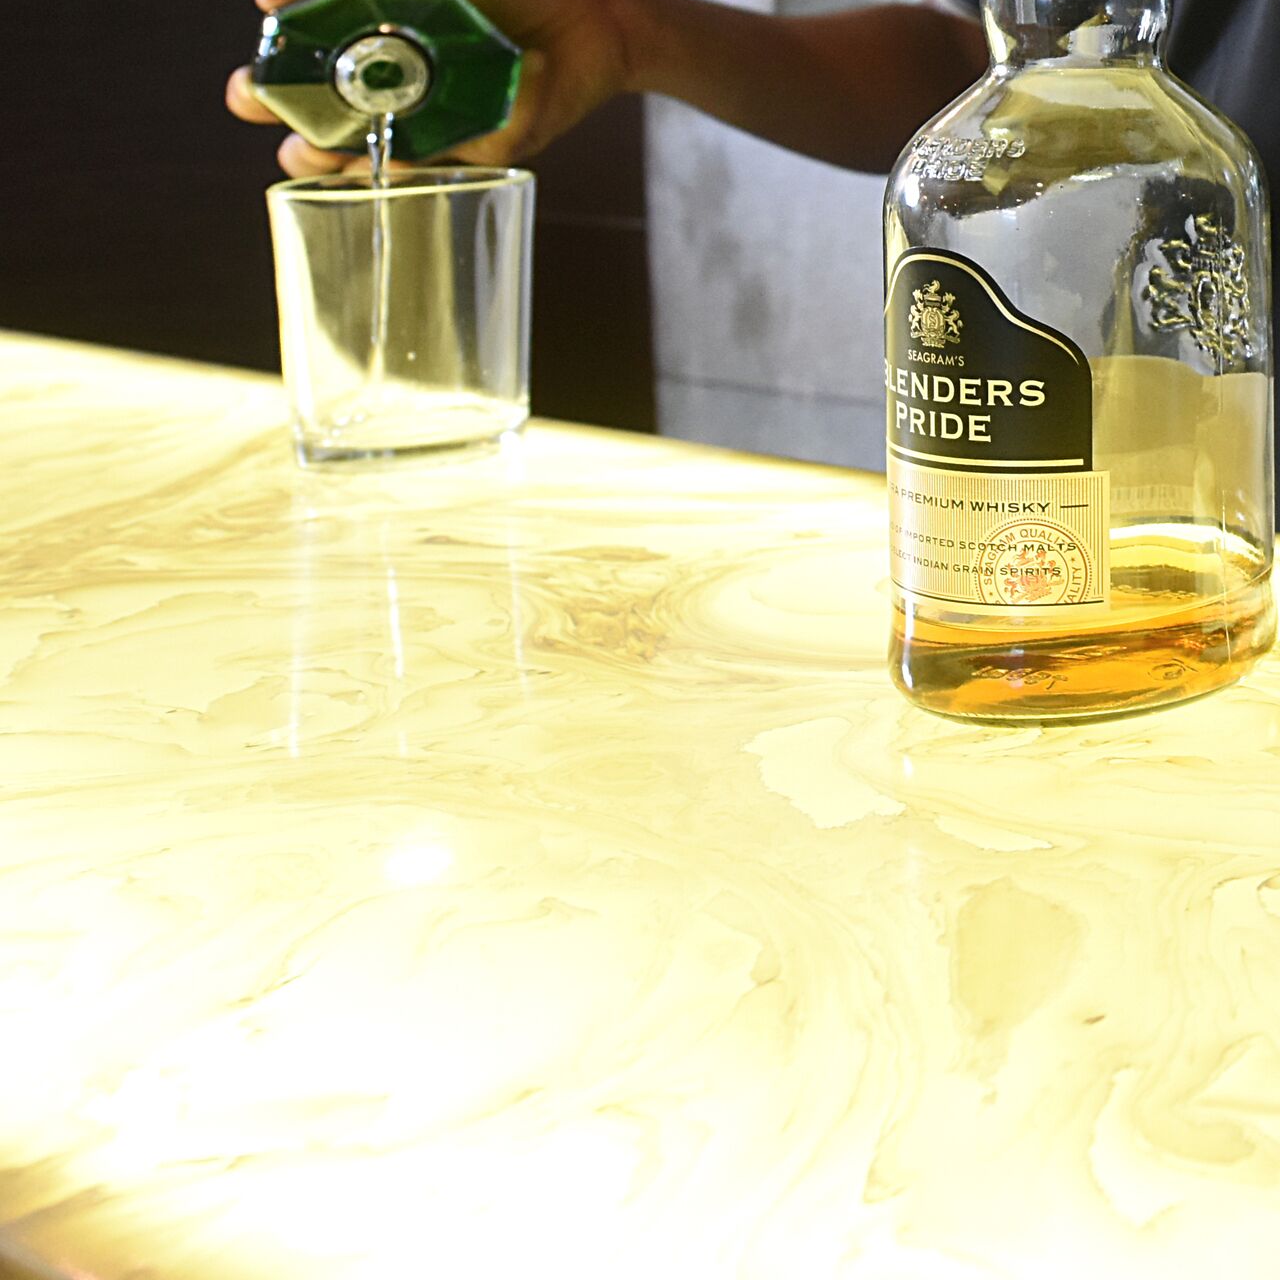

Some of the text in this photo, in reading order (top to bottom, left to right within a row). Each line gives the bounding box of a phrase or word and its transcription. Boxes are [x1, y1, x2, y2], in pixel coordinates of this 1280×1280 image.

[908, 349, 965, 367] SEAGRAM'S
[895, 400, 992, 443] PRIDE
[901, 488, 964, 511] PREMIUM
[969, 501, 1051, 513] WHISKY
[959, 540, 1018, 552] SCOTCH
[1023, 541, 1077, 553] MALTS
[913, 556, 949, 571] INDIAN
[952, 564, 994, 575] GRAIN
[999, 566, 1062, 577] SPIRITS
[1064, 566, 1083, 604] ALITY
